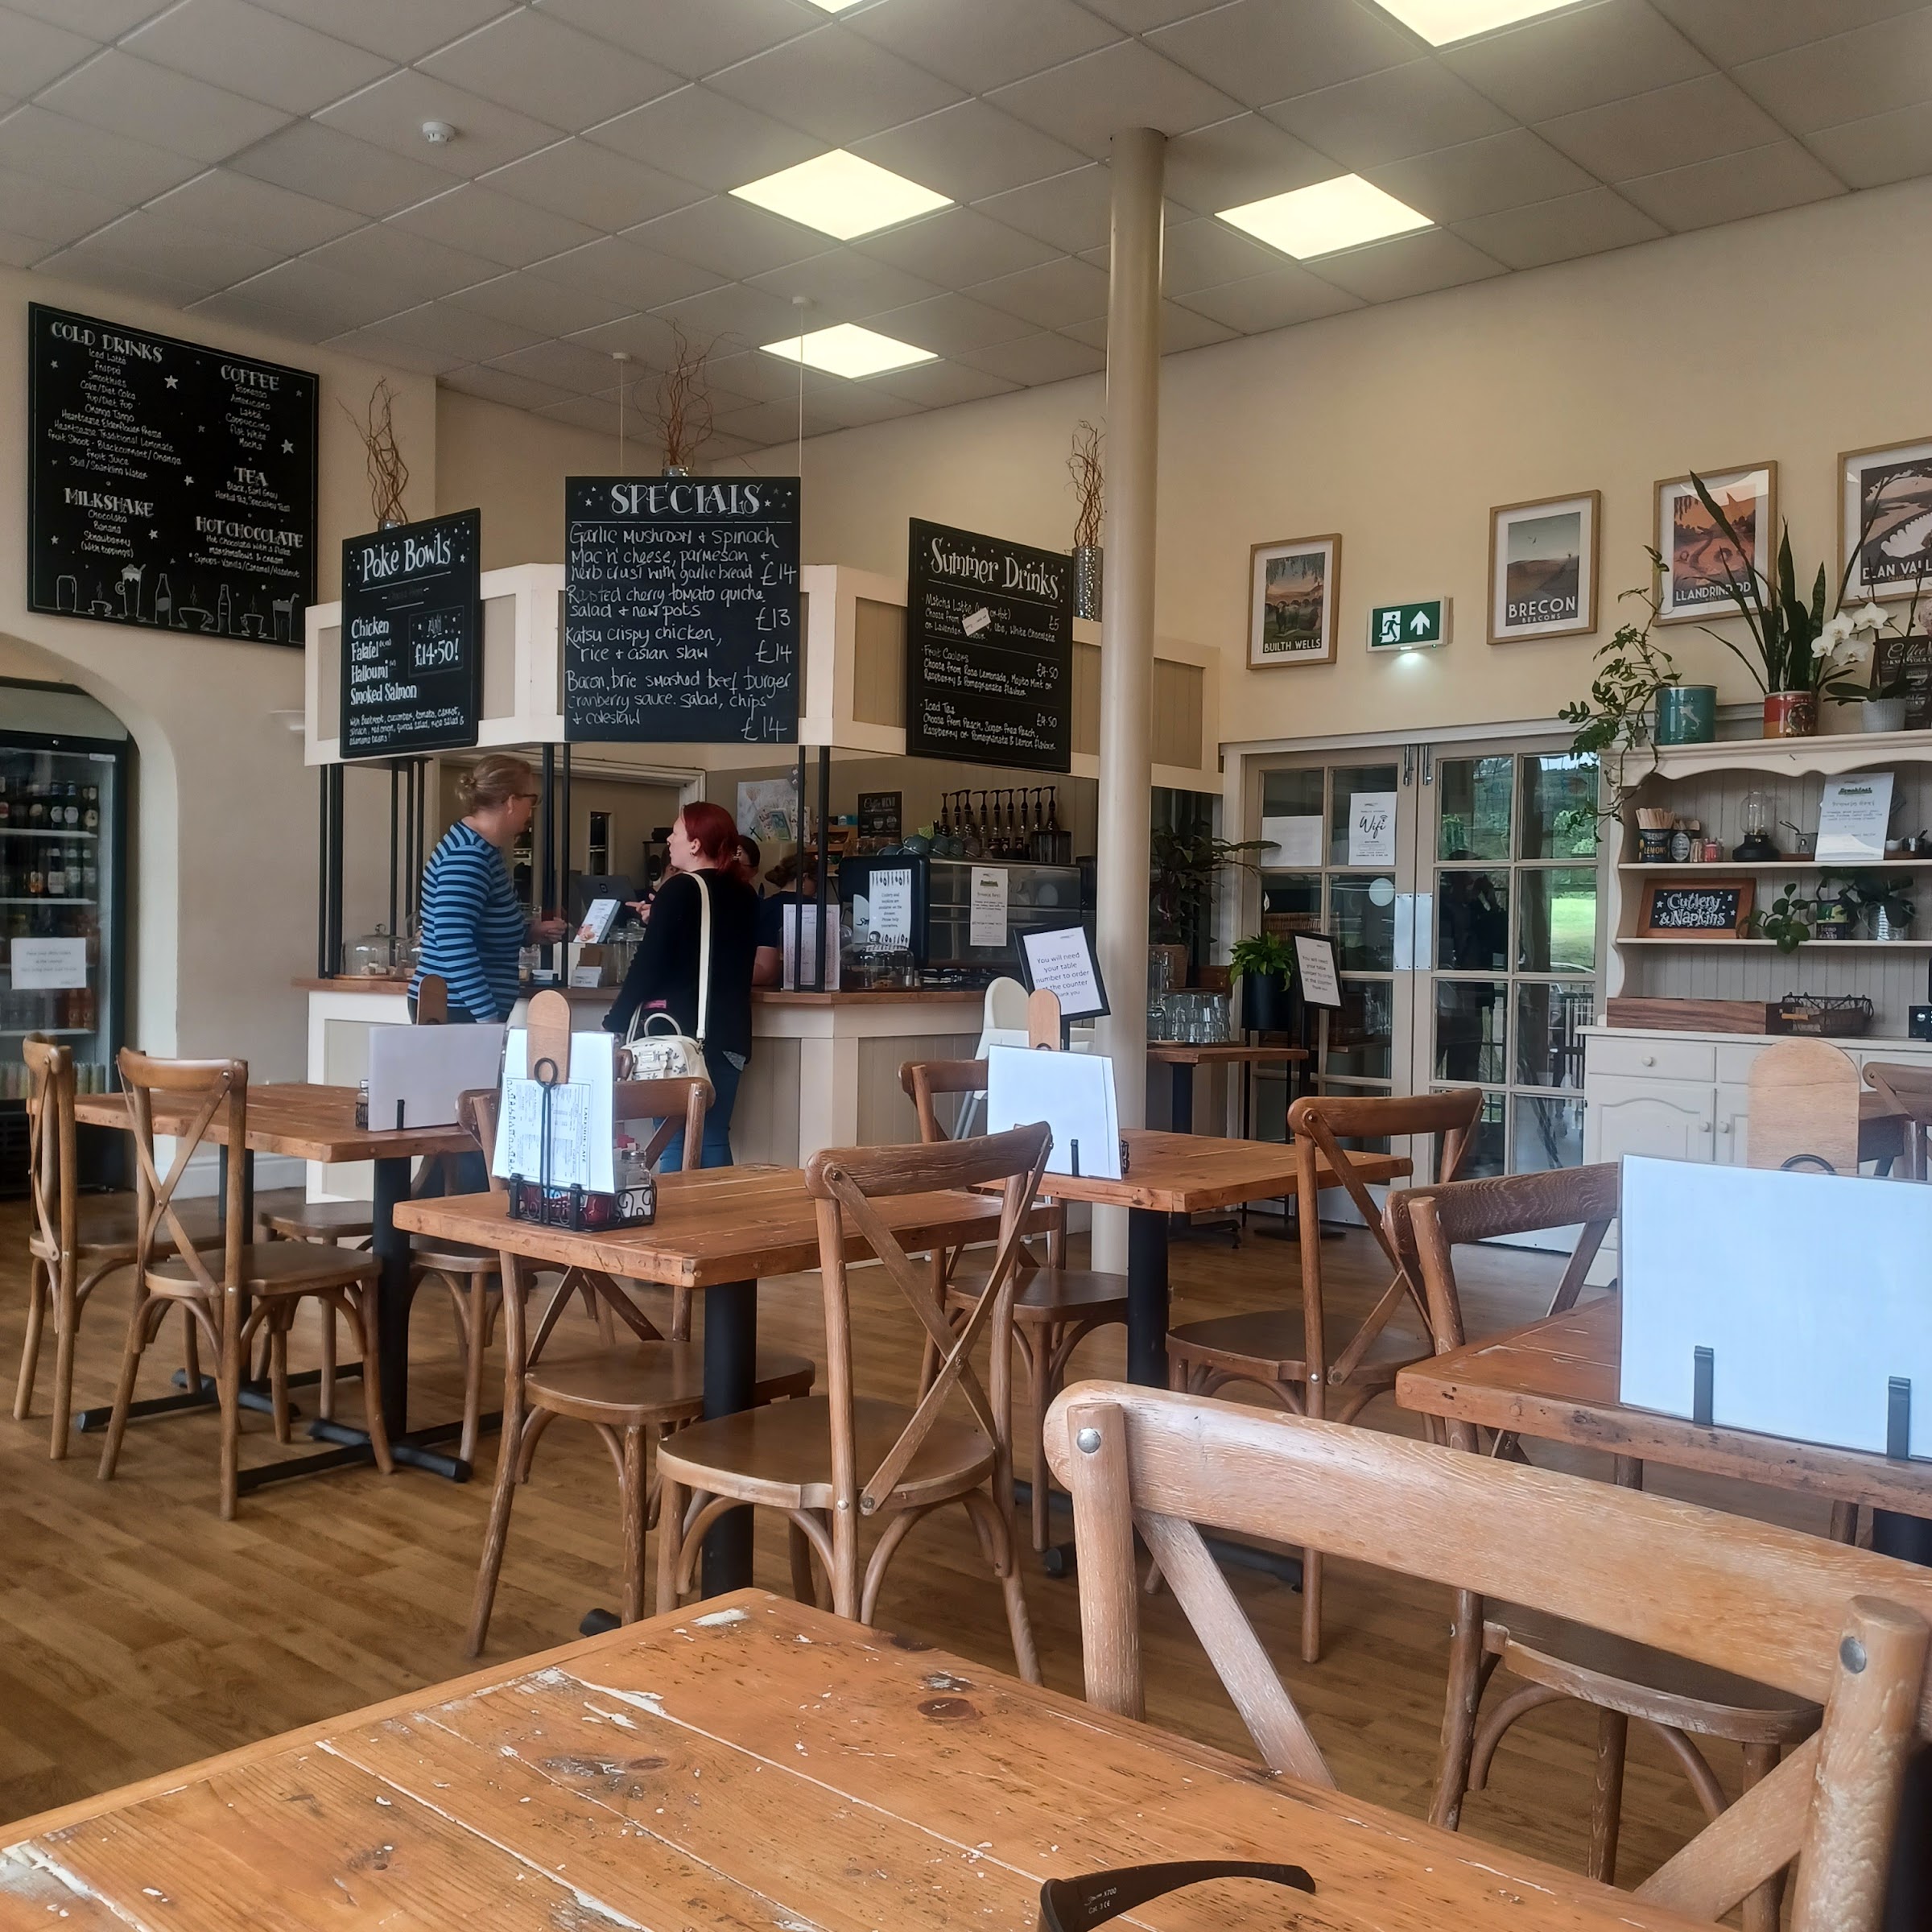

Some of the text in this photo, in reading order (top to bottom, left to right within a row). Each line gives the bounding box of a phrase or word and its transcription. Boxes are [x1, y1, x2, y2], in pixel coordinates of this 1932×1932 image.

[52, 322, 163, 362] COLD DRINKS
[89, 348, 105, 359] Iced
[88, 370, 127, 388] Smoothies
[221, 365, 279, 390] COFFEE
[118, 389, 136, 400] Coke
[231, 394, 270, 410] Americano
[235, 384, 267, 398] Espresso
[85, 403, 134, 423] Orange Tango
[225, 412, 270, 431] Cappuccino
[98, 429, 138, 444] Traditional
[141, 437, 174, 452] Lemonade
[239, 437, 262, 450] Mocha
[109, 454, 129, 465] Juice
[125, 468, 148, 479] Water
[233, 465, 269, 487] TEA
[64, 488, 154, 518] MILKSHAKE
[610, 482, 763, 516] SPECIALS
[88, 510, 127, 523] Chocolate
[93, 520, 121, 534] Banana
[84, 530, 130, 547] Strawberry
[196, 516, 303, 548] HOT CHOCOLATE
[206, 535, 251, 548] Hot Chocolate
[570, 524, 618, 547] Garlic
[362, 532, 452, 583] Poke Bowls
[624, 548, 676, 567] cheese,
[680, 551, 748, 570] parmesan
[572, 562, 797, 586] herb crust with garlic bread £14
[931, 537, 1059, 601] Summer Drinks
[566, 585, 621, 605] Roasted
[626, 586, 665, 605] cherry
[669, 583, 715, 602] tomato
[926, 593, 951, 609] Matcha
[570, 604, 701, 626] salad new pots
[1509, 596, 1575, 618] BRECON
[352, 616, 390, 639] Chicken
[755, 607, 791, 631] £13
[926, 608, 944, 620] Choose
[946, 610, 960, 623] from
[1010, 625, 1027, 638] White
[1027, 628, 1055, 642] Chocolate
[935, 621, 962, 634] Lavender
[1048, 615, 1059, 630] £5
[1522, 613, 1561, 624] BEACONS
[566, 625, 722, 649] Katsu crispy chicken,
[1264, 638, 1321, 653] BUILTH WELLS
[351, 641, 379, 662] Falafel
[580, 646, 609, 662] rice
[676, 645, 708, 659] slaw
[755, 640, 792, 663] £14
[924, 645, 969, 663] Fruit Coolers
[351, 659, 388, 684] Halloumi
[611, 667, 637, 688] brie
[708, 668, 737, 696] beef
[924, 658, 945, 671] Choose
[947, 661, 962, 675] from
[964, 664, 978, 676] Rose
[979, 669, 1009, 683] Lemonade,
[1011, 674, 1030, 687] Mojito
[1030, 678, 1043, 689] Mint
[924, 668, 956, 687] Raspberry
[964, 676, 1002, 692] Pomegranate
[350, 682, 417, 706] Smoked Salmon
[568, 693, 630, 714] cranberry
[729, 693, 766, 720] chips
[586, 708, 641, 725] coleslaw
[924, 699, 956, 715] Iced Tea
[741, 716, 787, 742] £14
[923, 712, 944, 724] Choose
[947, 715, 961, 727] from
[963, 717, 983, 731] Peach,
[985, 721, 1003, 734] Sugar
[923, 724, 958, 740] Raspberry
[971, 729, 1008, 745] Pomegranate
[1015, 737, 1033, 748] Lemon
[1360, 815, 1386, 839] Wifi
[1667, 892, 1721, 913] Cutlery
[1659, 909, 1725, 927] & Napkins
[1036, 975, 1061, 983] number
[1063, 980, 1088, 989] counter
